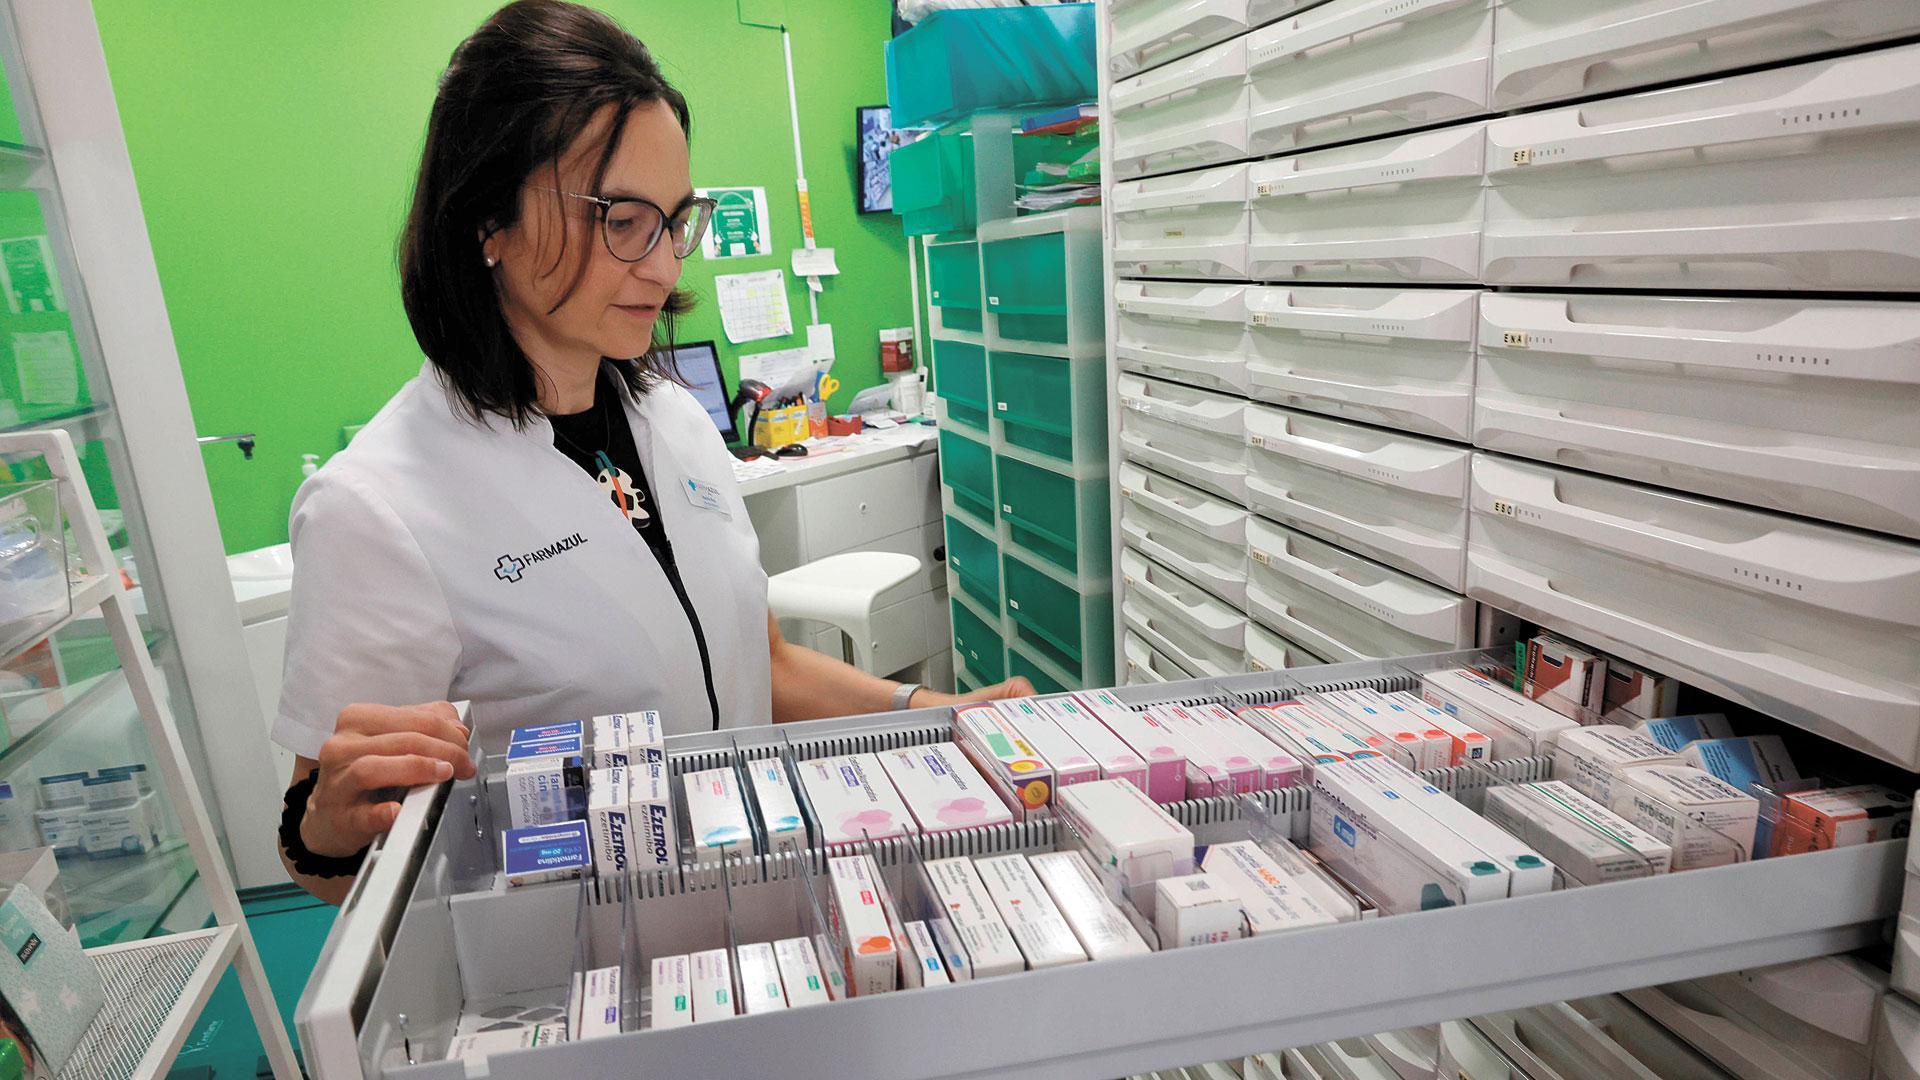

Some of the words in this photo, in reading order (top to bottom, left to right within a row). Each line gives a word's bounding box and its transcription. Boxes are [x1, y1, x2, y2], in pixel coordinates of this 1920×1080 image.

[1504, 333, 1522, 344] ENA
[523, 532, 588, 567] FARMAZUL
[641, 804, 654, 854] ezetimiba
[1631, 796, 1678, 829] Ferbisol
[599, 812, 613, 861] ezetimiba
[608, 811, 627, 871] EZETROL
[649, 804, 670, 865] EZETROL
[537, 854, 582, 864] Famotidina
